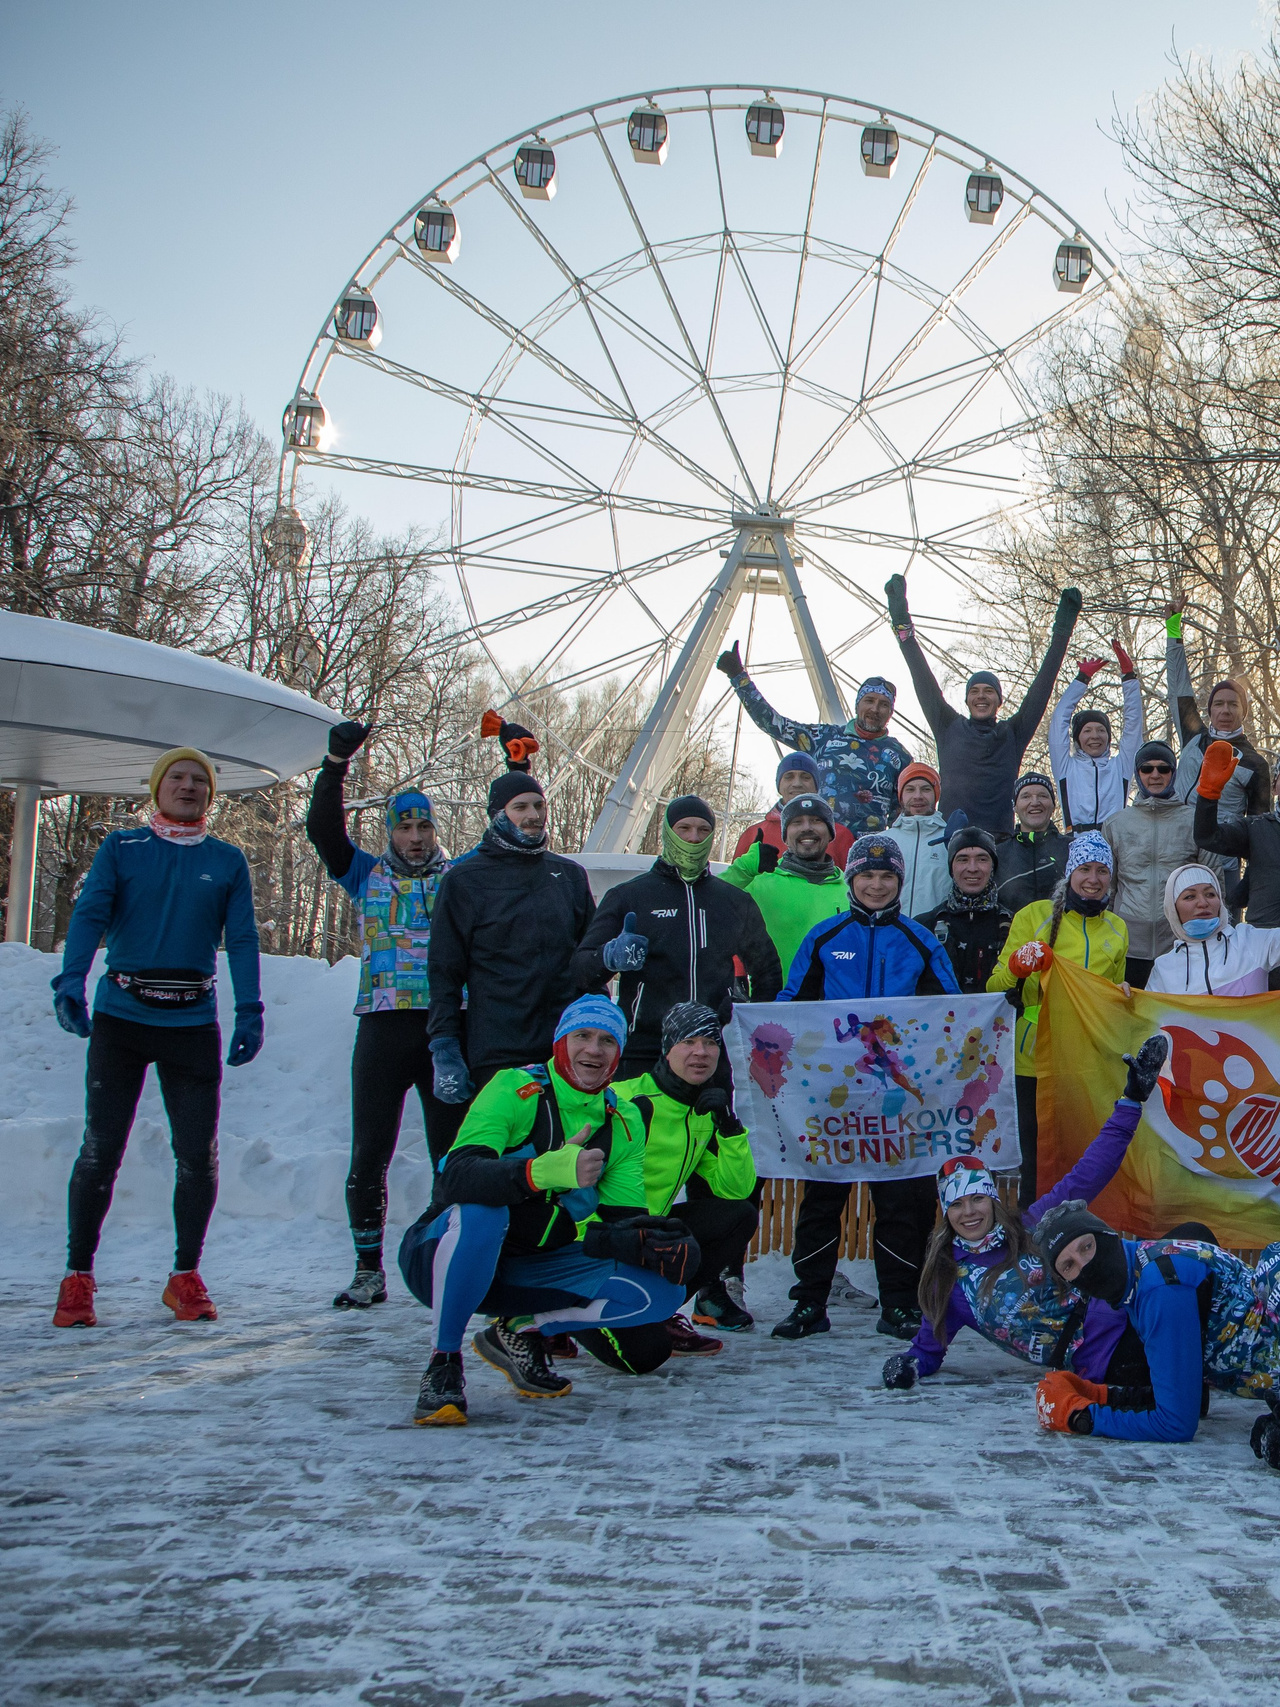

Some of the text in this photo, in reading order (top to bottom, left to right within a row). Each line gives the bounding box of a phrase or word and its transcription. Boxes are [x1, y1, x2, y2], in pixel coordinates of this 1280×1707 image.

[651, 908, 678, 918] RAY
[831, 951, 856, 960] RAY
[805, 1105, 974, 1137] SCHELKOVO
[810, 1128, 976, 1165] RUNNERS
